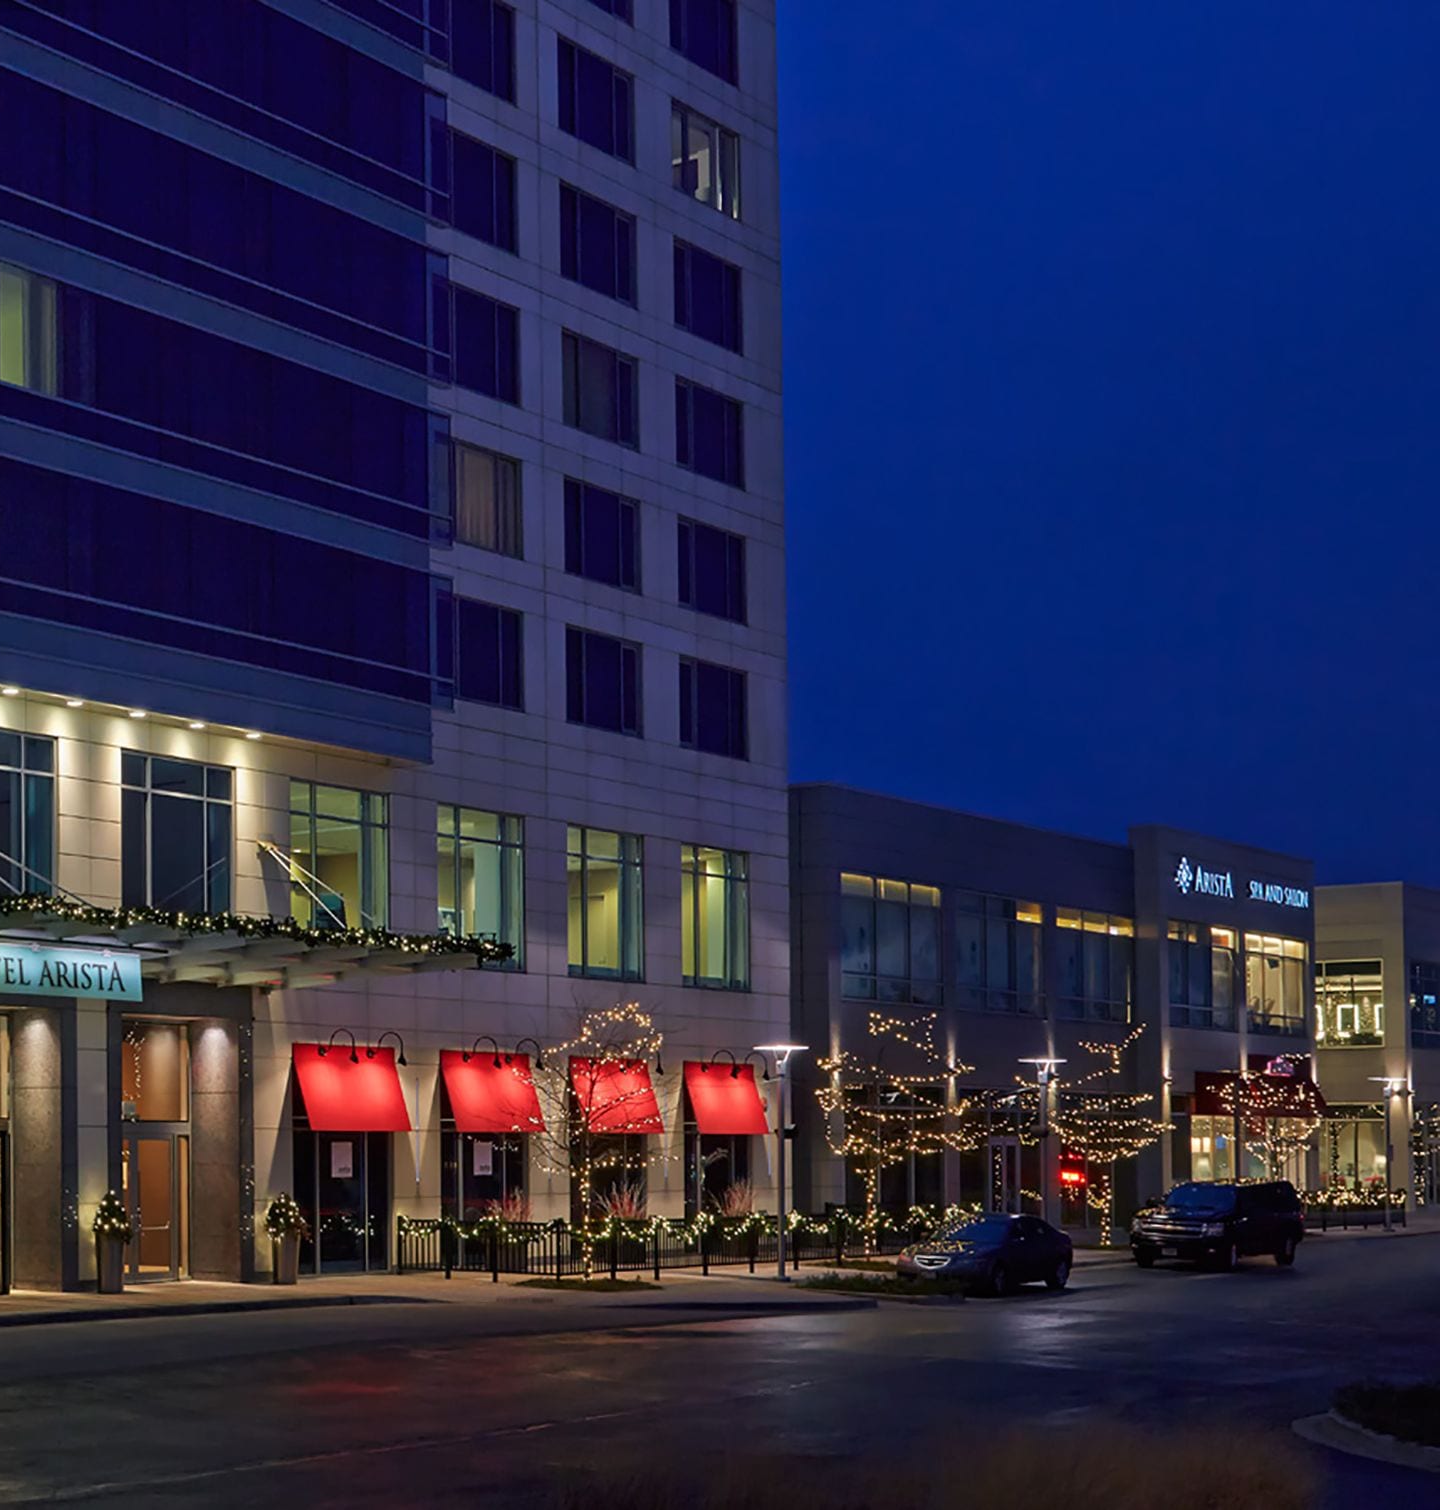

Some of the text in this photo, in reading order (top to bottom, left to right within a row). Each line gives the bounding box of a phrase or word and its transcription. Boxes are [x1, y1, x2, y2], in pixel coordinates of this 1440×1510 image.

[1195, 865, 1309, 908] ARISTA SPA AND SALON
[38, 959, 126, 992] ARISTA
